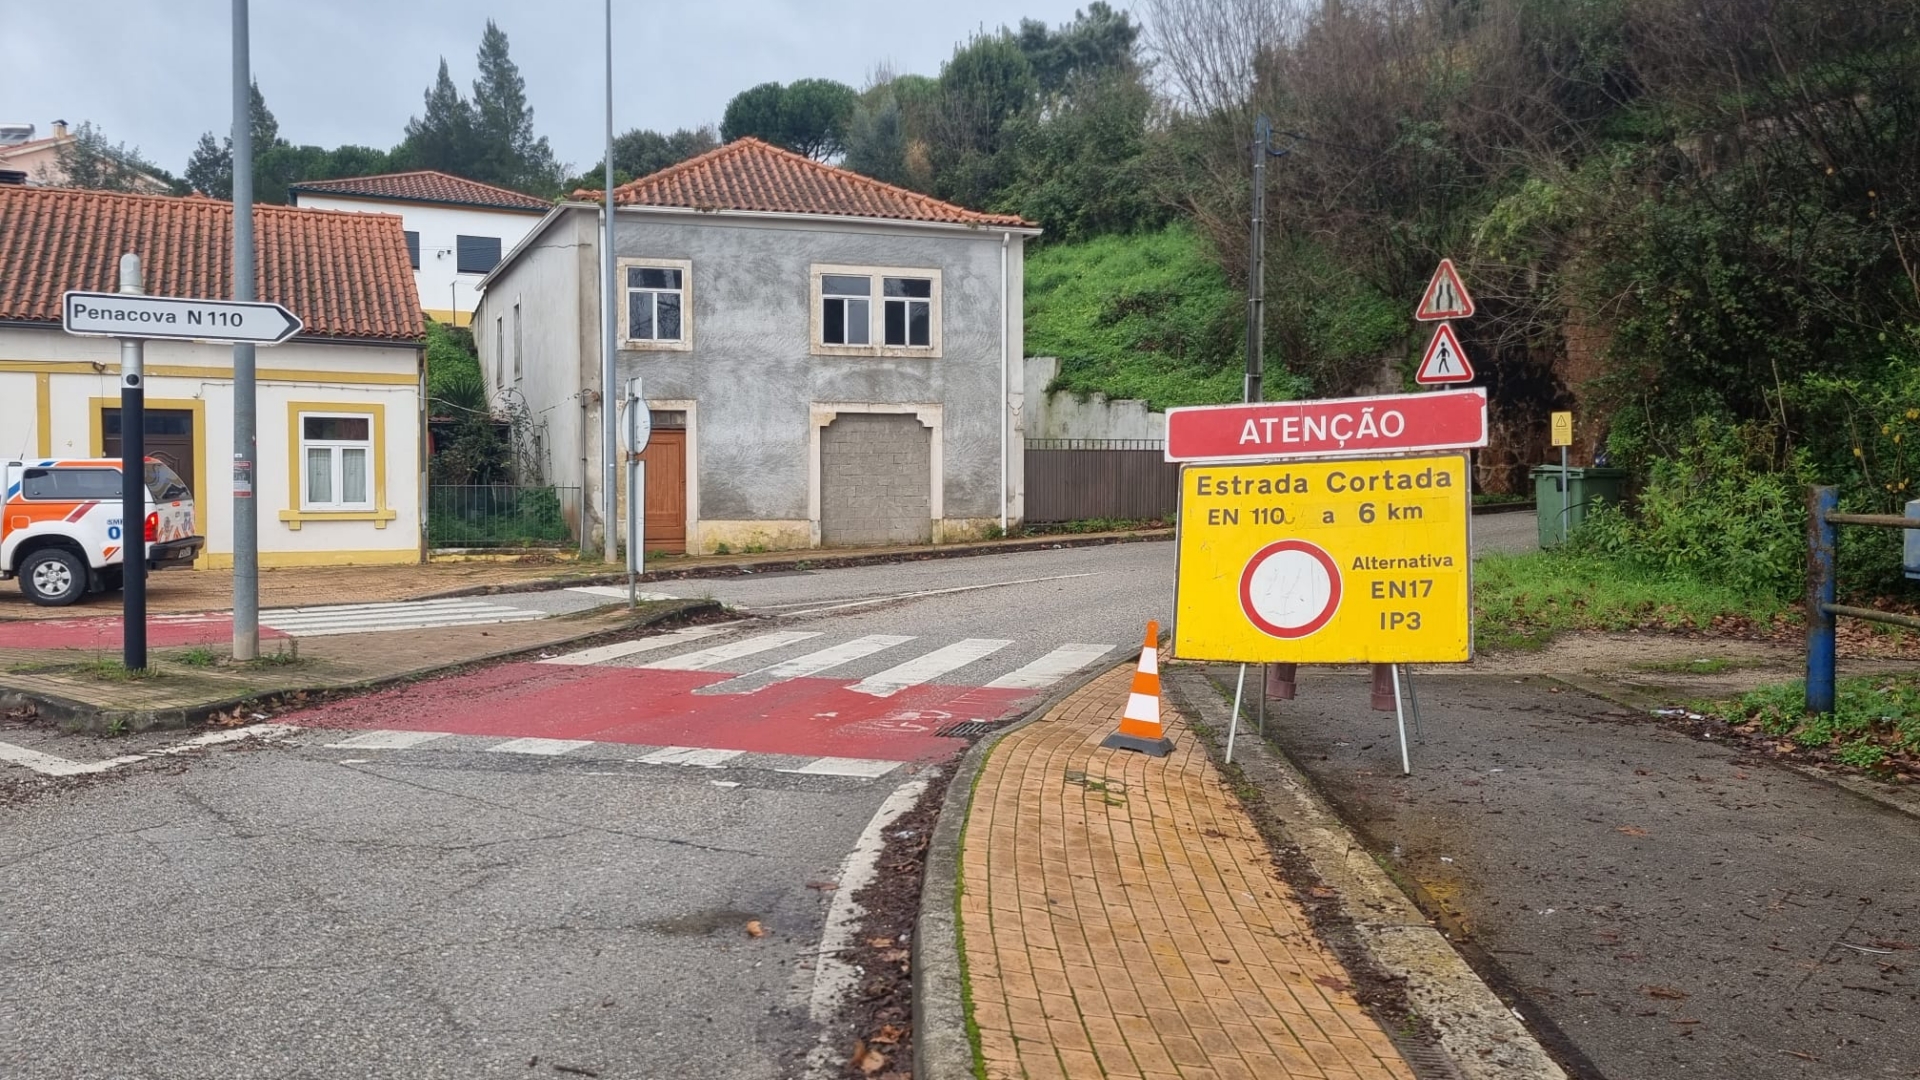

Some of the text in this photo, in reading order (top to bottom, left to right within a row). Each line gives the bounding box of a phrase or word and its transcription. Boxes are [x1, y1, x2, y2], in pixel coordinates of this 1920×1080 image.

[73, 303, 177, 324] Penacova
[1239, 406, 1405, 448] ATENÇÃO
[1197, 467, 1452, 496] Estrada Cortada
[1208, 502, 1423, 526] EN 110 a 6 km
[1352, 554, 1454, 571] Alternativa
[1371, 579, 1434, 599] EN17
[1380, 611, 1422, 631] IP3
